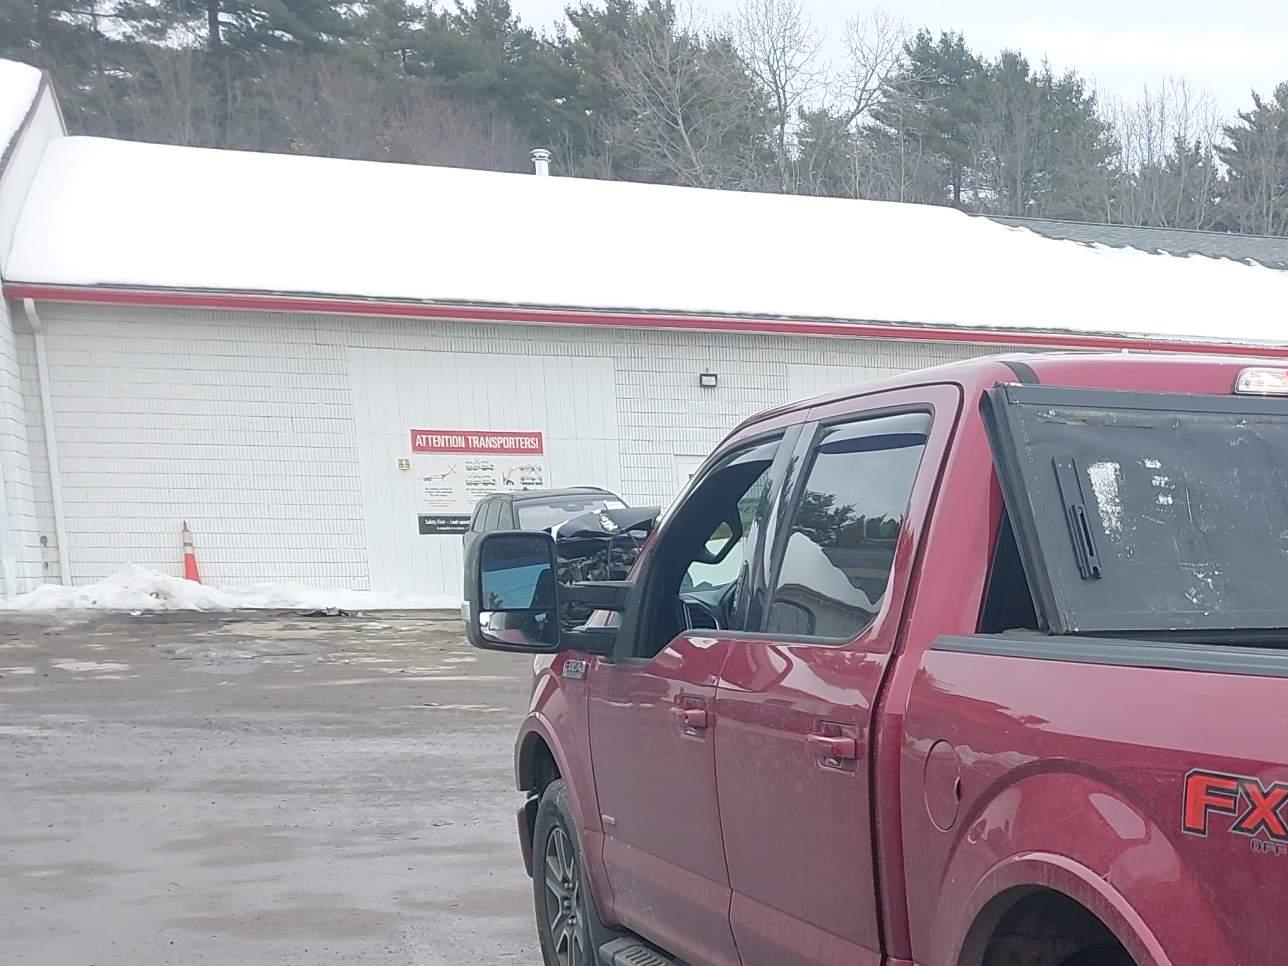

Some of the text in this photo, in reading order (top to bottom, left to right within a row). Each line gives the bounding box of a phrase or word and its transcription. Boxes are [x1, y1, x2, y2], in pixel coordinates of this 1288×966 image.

[415, 434, 539, 449] ATTENTION TRANSPORTERS!
[1250, 838, 1288, 856] OFF
